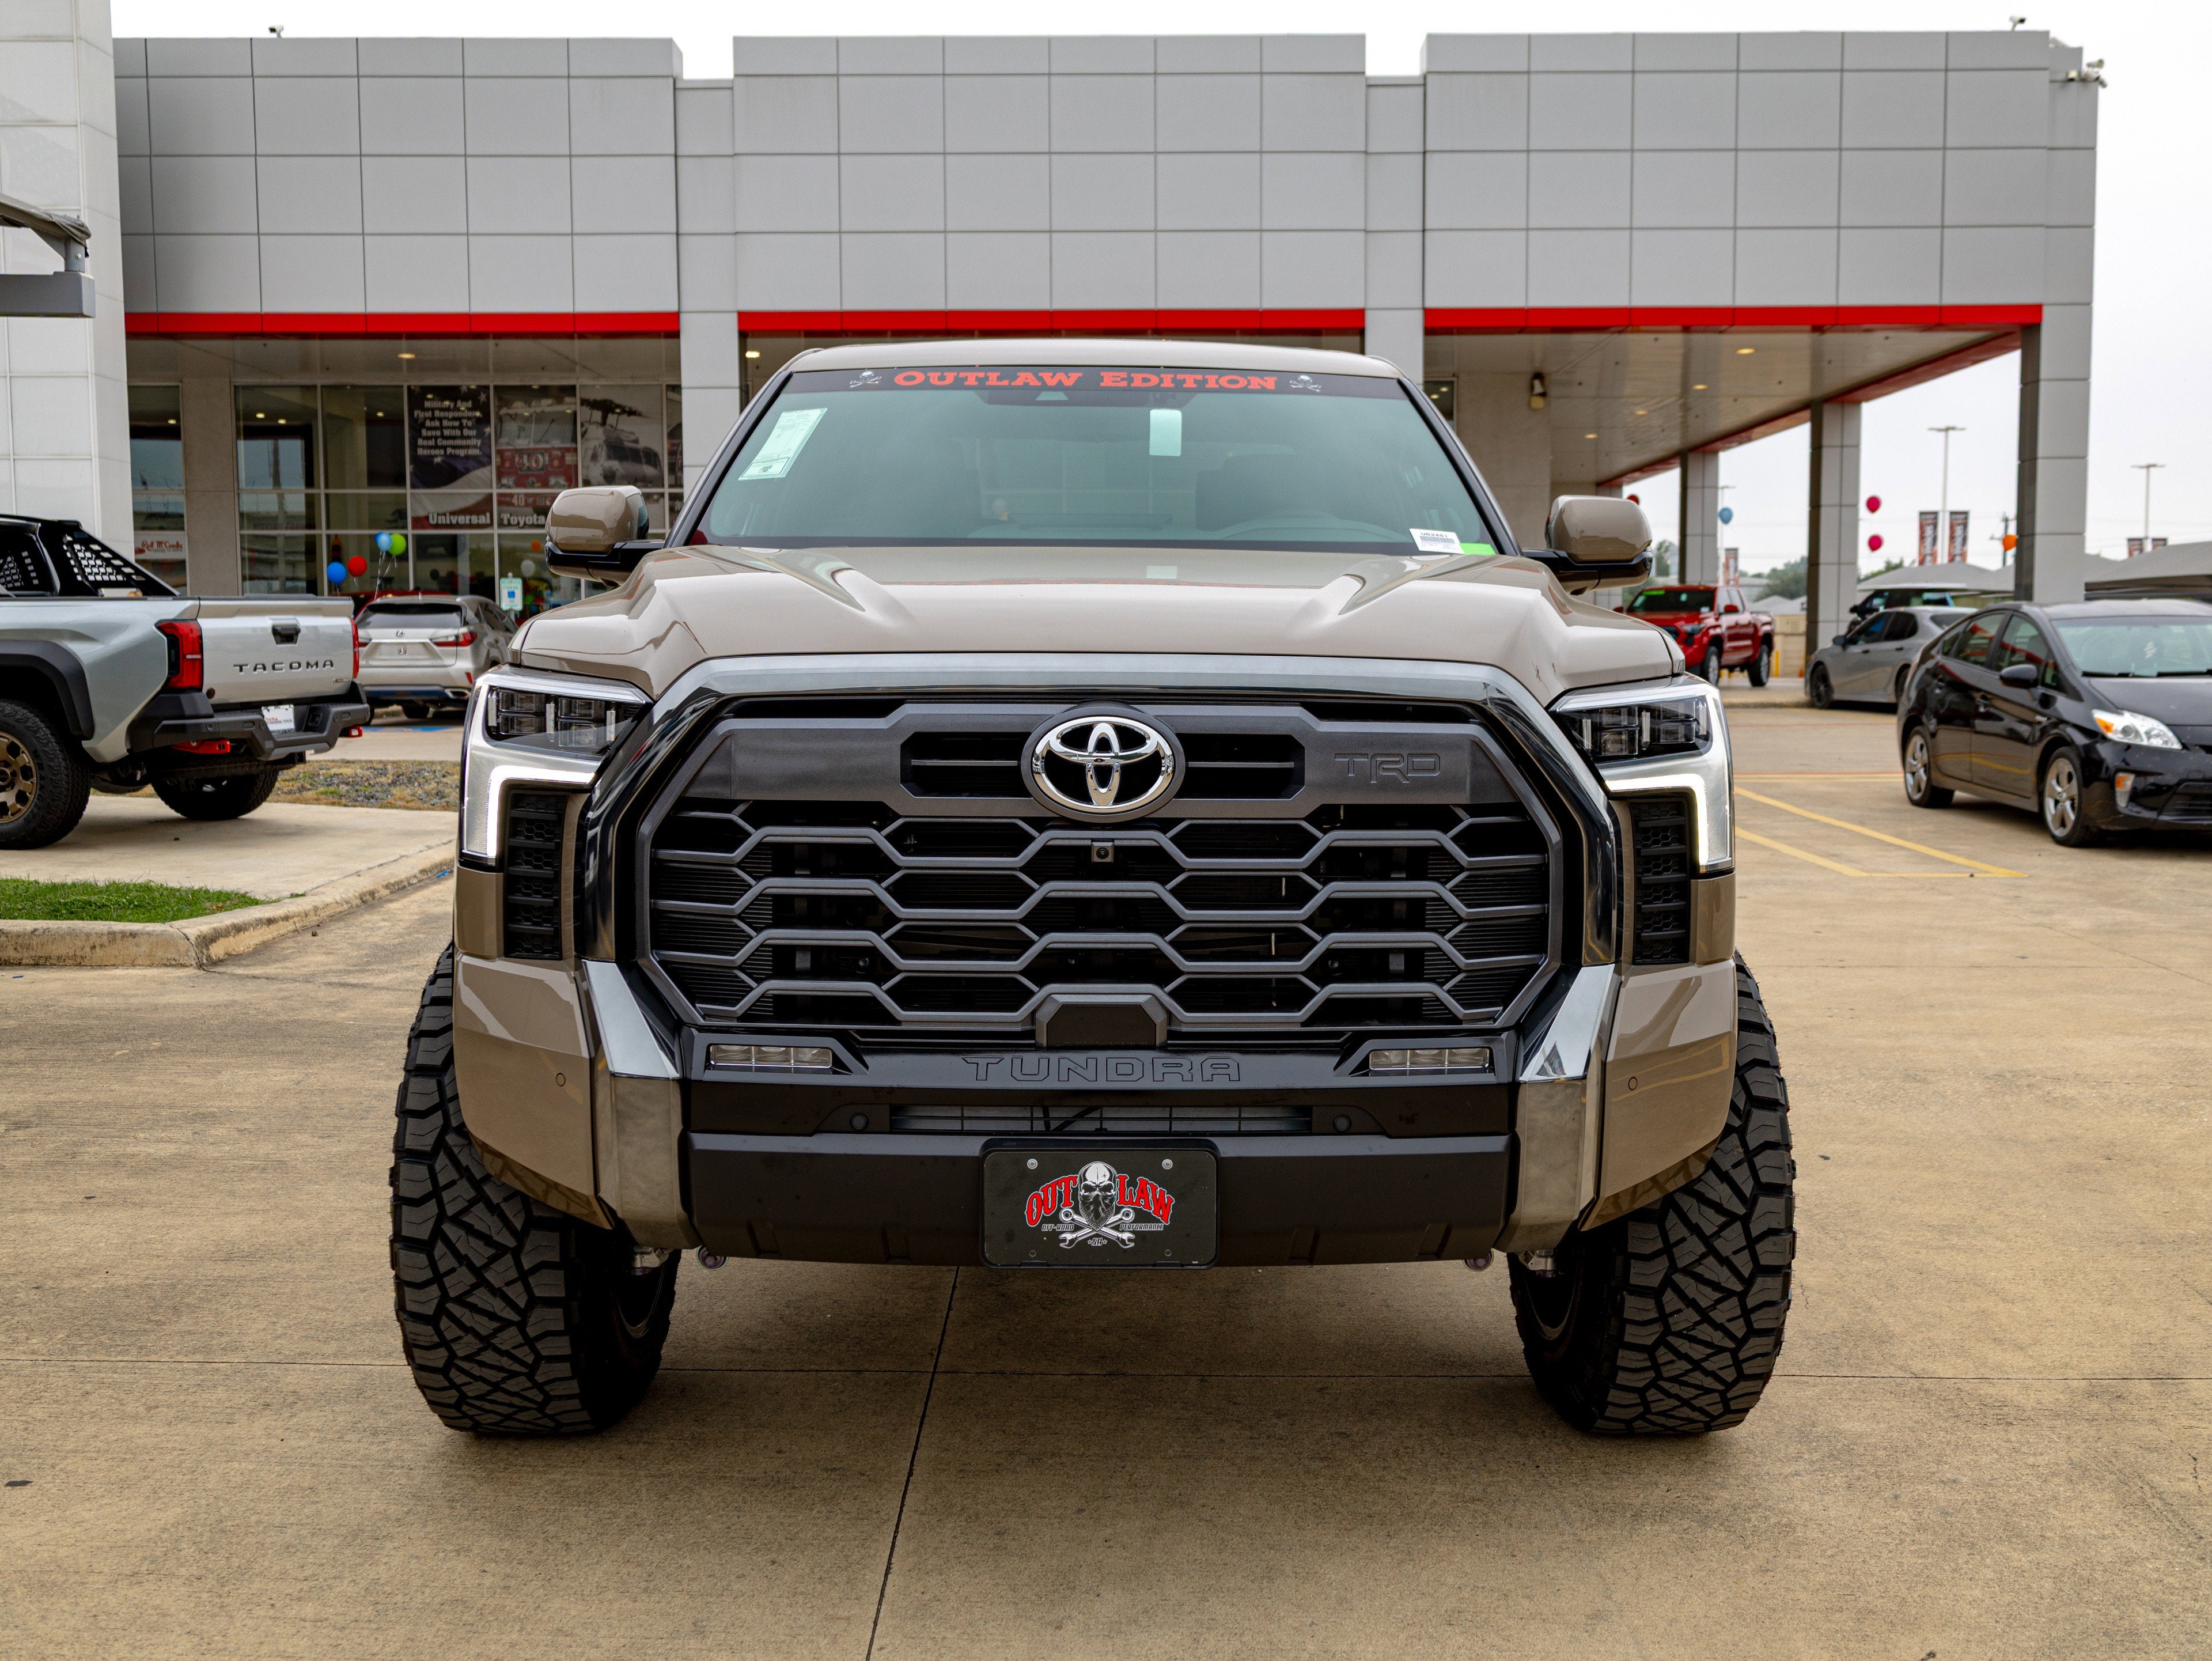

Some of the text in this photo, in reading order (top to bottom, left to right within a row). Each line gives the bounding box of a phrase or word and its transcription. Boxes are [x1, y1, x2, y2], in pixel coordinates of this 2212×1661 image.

[894, 371, 1277, 389] OUTLAW EDITION
[425, 400, 472, 409] Military And
[417, 438, 481, 447] Real Community
[428, 512, 546, 527] Universal Toyota
[233, 660, 334, 675] TACOMA
[1334, 753, 1441, 784] TRD
[961, 1055, 1241, 1082] TUNDRA
[1092, 1238, 1104, 1246] SA
